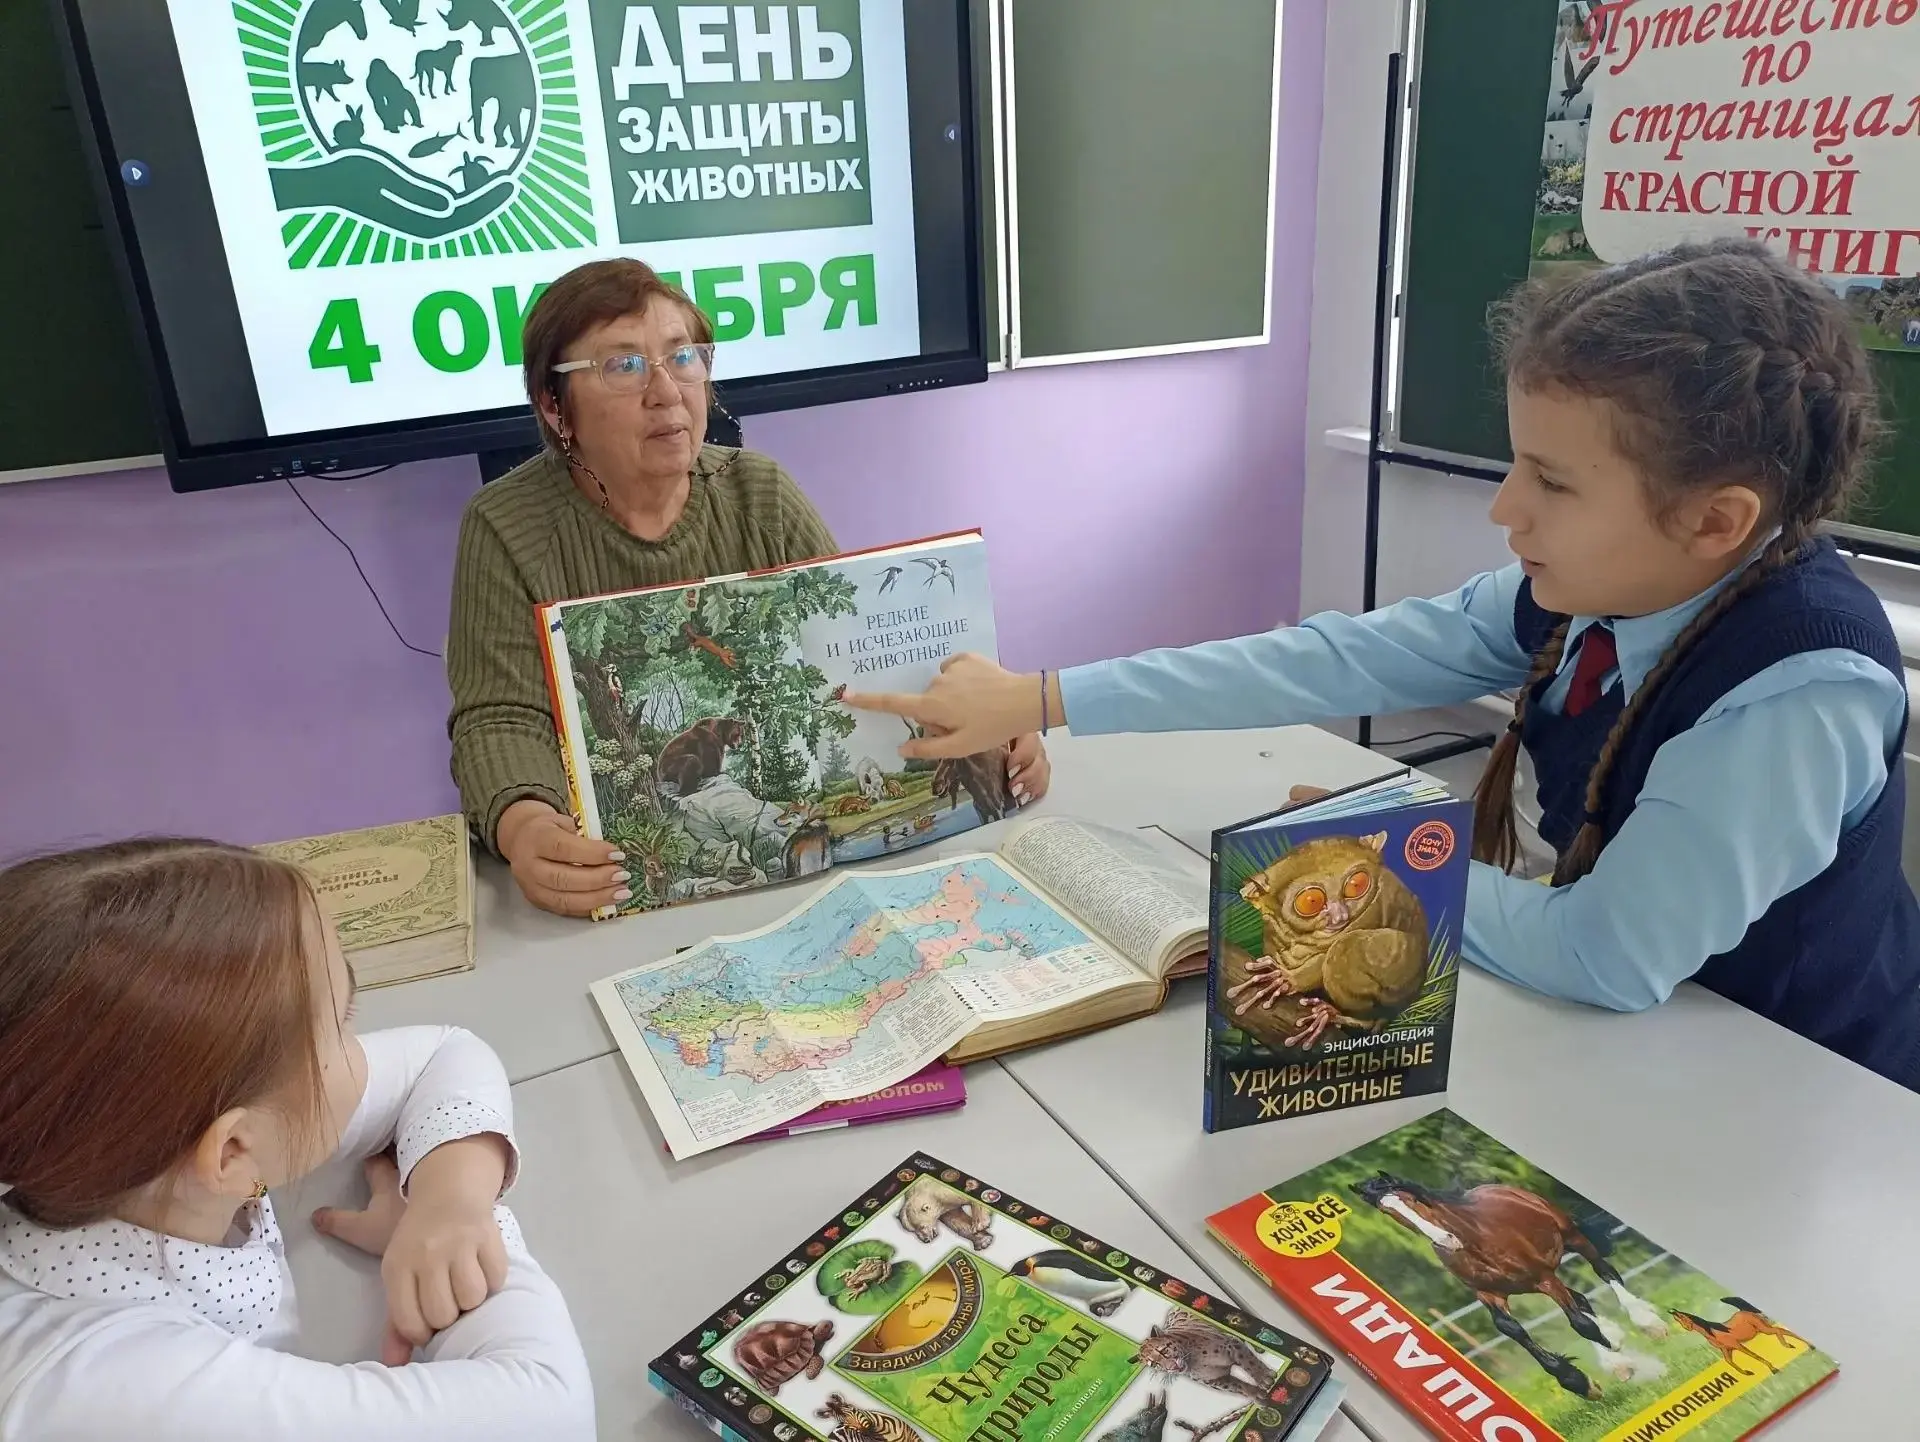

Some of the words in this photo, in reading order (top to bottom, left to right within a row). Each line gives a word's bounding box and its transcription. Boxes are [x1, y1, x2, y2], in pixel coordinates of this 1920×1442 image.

[611, 5, 853, 100] ДЕНЬ
[1741, 40, 1811, 87] по
[617, 100, 857, 157] ЗАЩИТЫ
[628, 158, 864, 205] ЖИВОТНЫХ
[1599, 154, 1861, 216] КРАСНОЙ
[308, 297, 381, 383] 4
[412, 253, 879, 373] ОБРЯ
[827, 643, 841, 658] И
[849, 618, 969, 654] ИСЧЕЗАЮЩИЕ
[866, 605, 930, 630] РЕДКИЕ
[851, 641, 952, 675] ЖИВОТНЫЕ
[316, 874, 399, 894] РИРОДЫ
[1324, 1026, 1435, 1054] ЭНЦИКЛОПЕДИЯ
[1229, 1041, 1435, 1098] УДИВИТЕЛЬНЫЕ
[1256, 1074, 1403, 1119] ЖИВОТНЫЕ
[1269, 1219, 1308, 1245] ХОЧУ
[1303, 1196, 1348, 1225] ВСЁ
[1289, 1228, 1336, 1255] ЗНАТЬ
[955, 1258, 976, 1296] мира
[941, 1302, 974, 1344] тайны
[849, 1350, 927, 1370] Загадки
[926, 1313, 1048, 1406] Чудеса
[929, 1341, 942, 1353] и
[1311, 1273, 1537, 1442] ОШАДИ
[1623, 1371, 1740, 1442] ЦИКЛОПЕДИЯ
